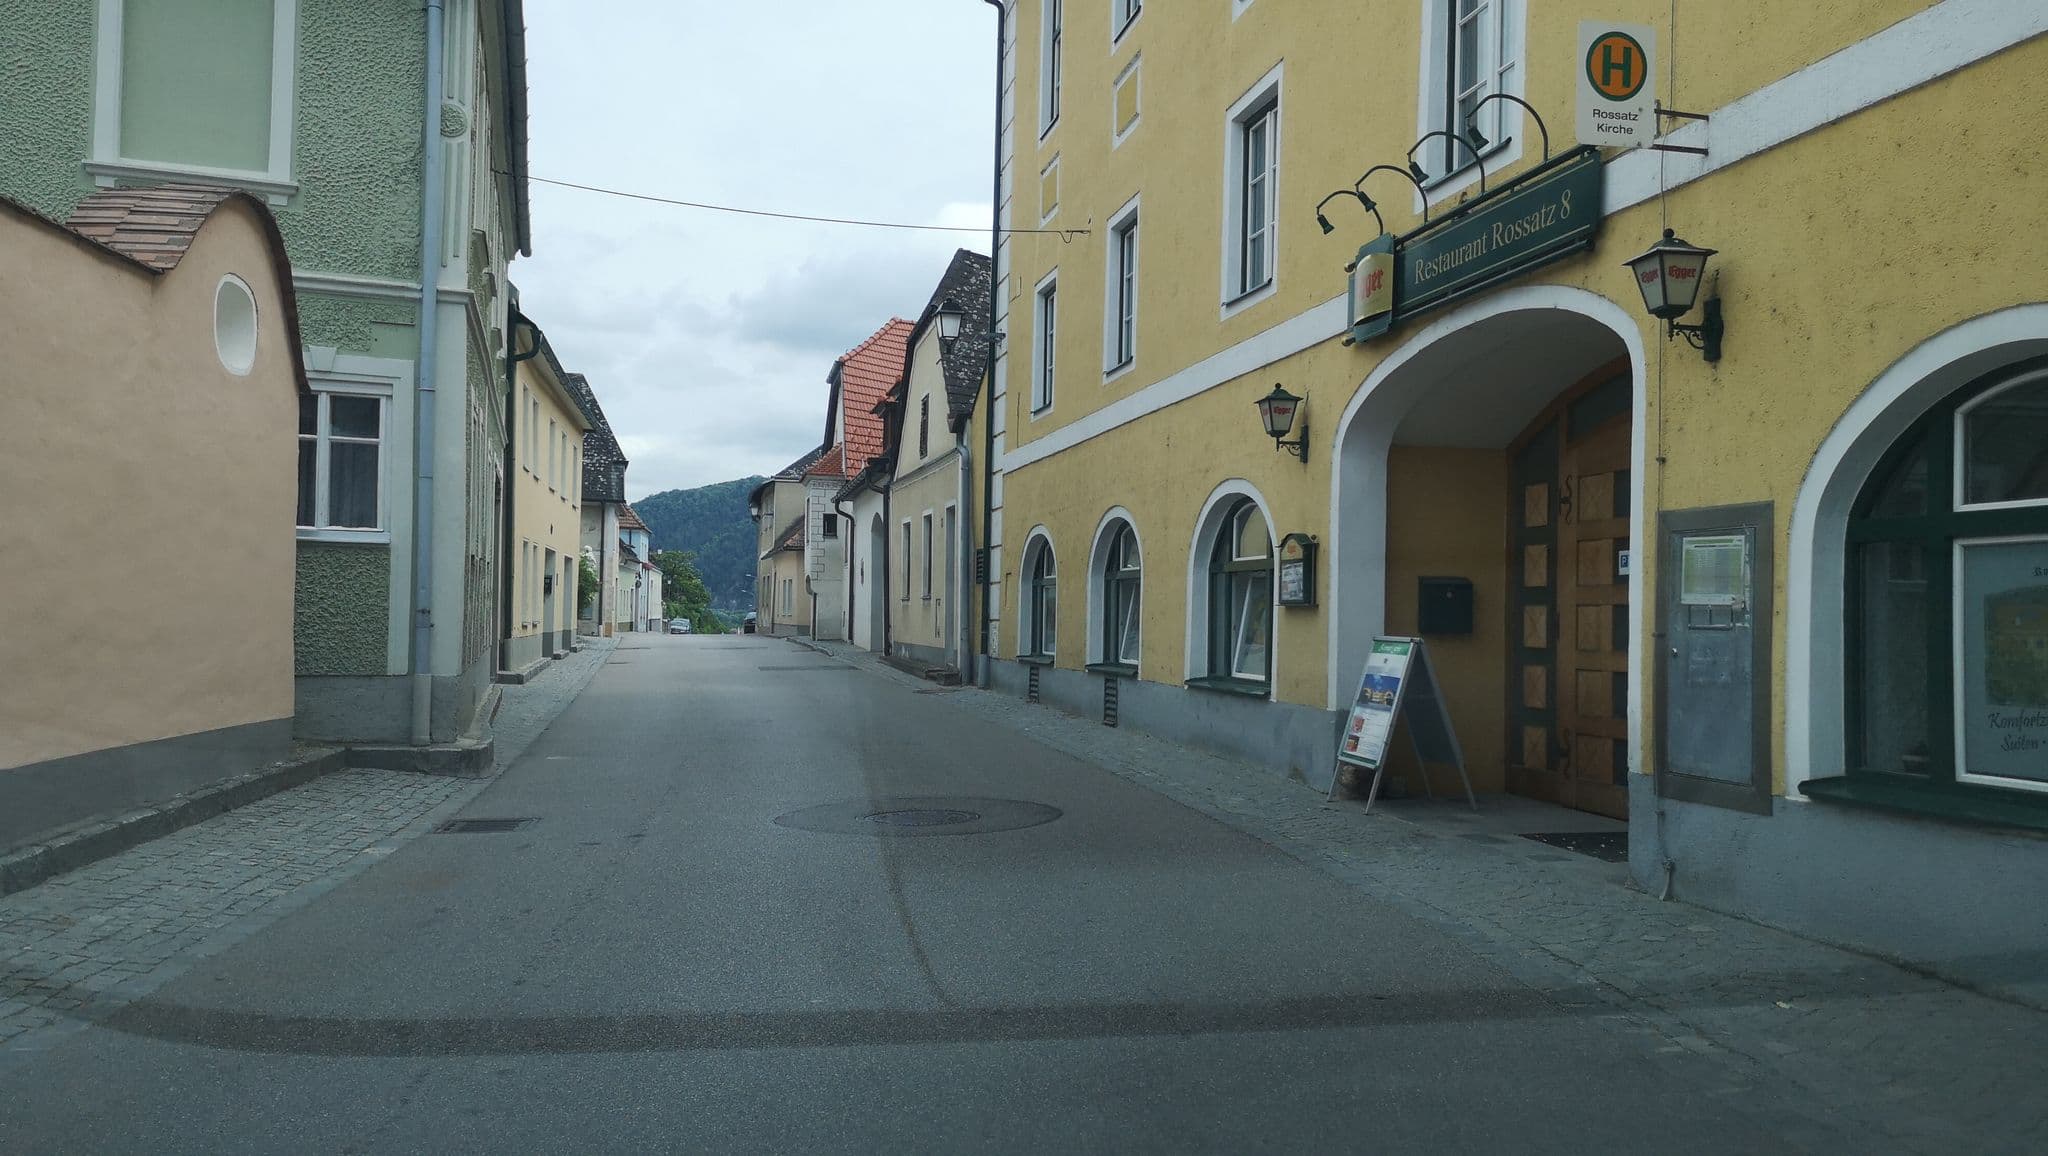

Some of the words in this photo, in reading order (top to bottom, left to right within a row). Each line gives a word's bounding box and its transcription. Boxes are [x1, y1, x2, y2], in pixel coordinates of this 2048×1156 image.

[1601, 44, 1633, 88] H
[1592, 108, 1639, 121] Rossatz
[1597, 123, 1633, 134] Kirche
[1414, 231, 1488, 284] Restaurant
[1491, 203, 1556, 250] Rossatz
[1560, 189, 1572, 219] 8
